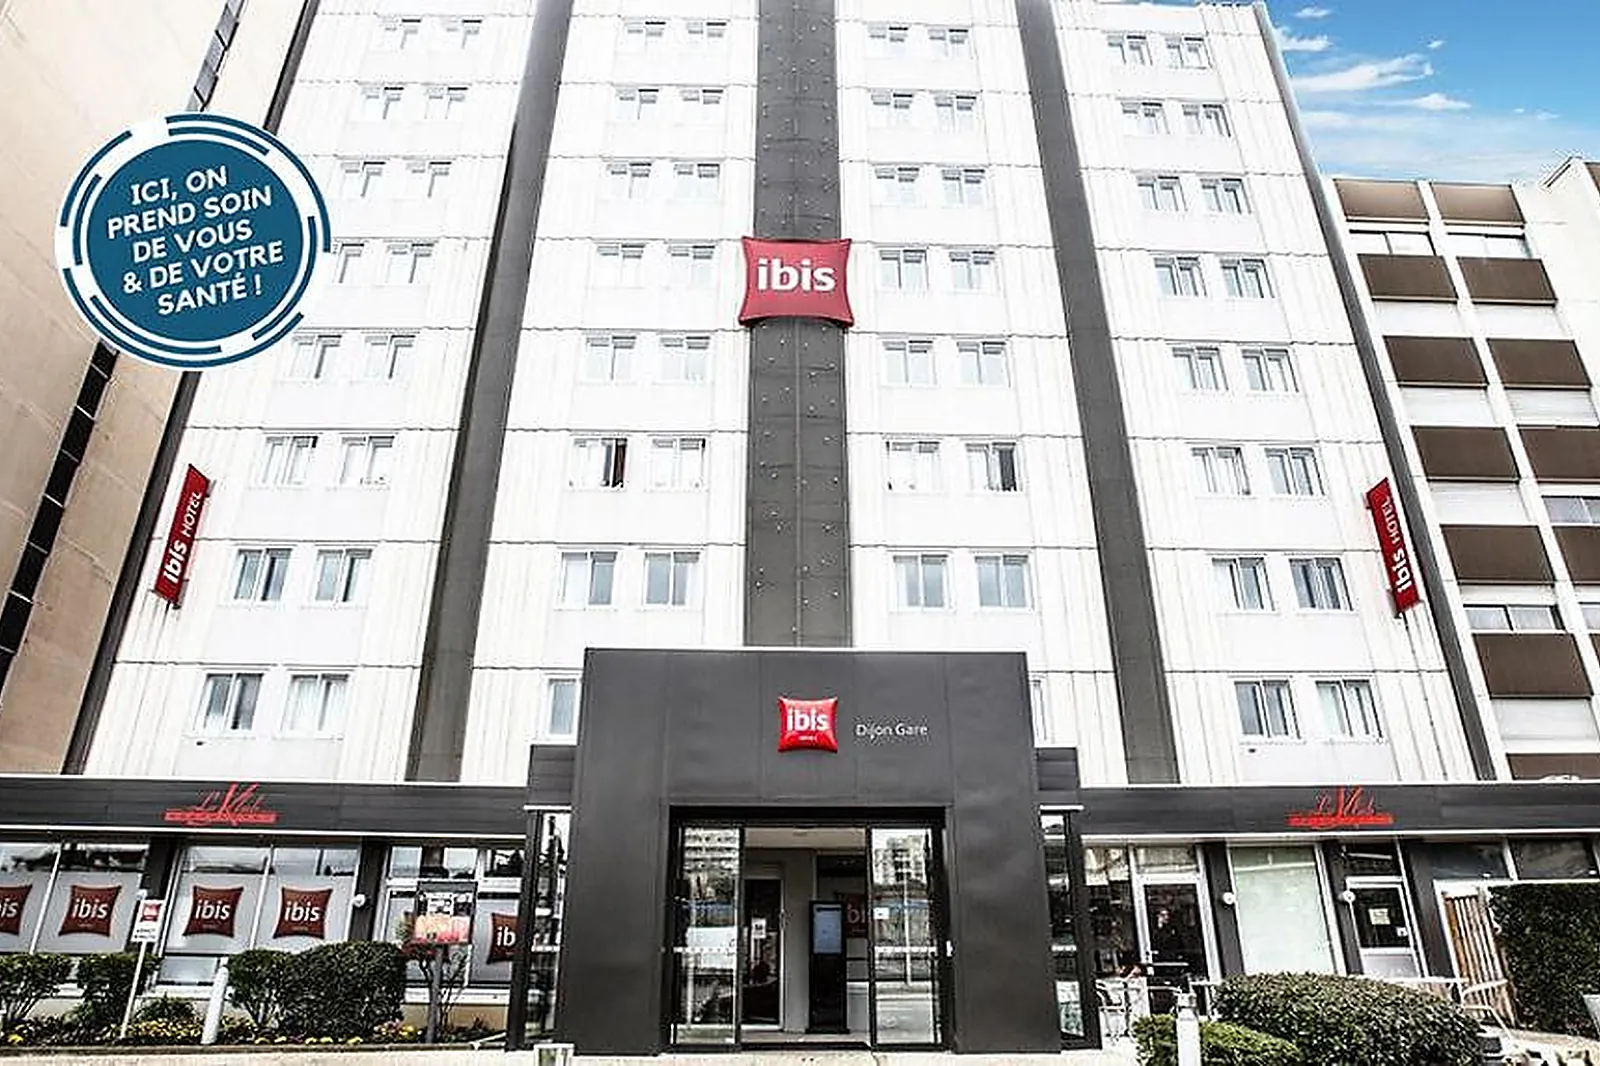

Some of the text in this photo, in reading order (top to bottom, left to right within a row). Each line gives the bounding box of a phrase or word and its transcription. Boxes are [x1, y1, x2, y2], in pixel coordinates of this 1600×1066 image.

[757, 257, 837, 293] ibis
[163, 541, 188, 584] ibis
[1392, 547, 1413, 592] ibis
[786, 707, 829, 732] ibis
[855, 723, 928, 740] Dijon Gare
[72, 898, 109, 919] ibis
[195, 899, 231, 920] ibis
[284, 900, 321, 922] ibis
